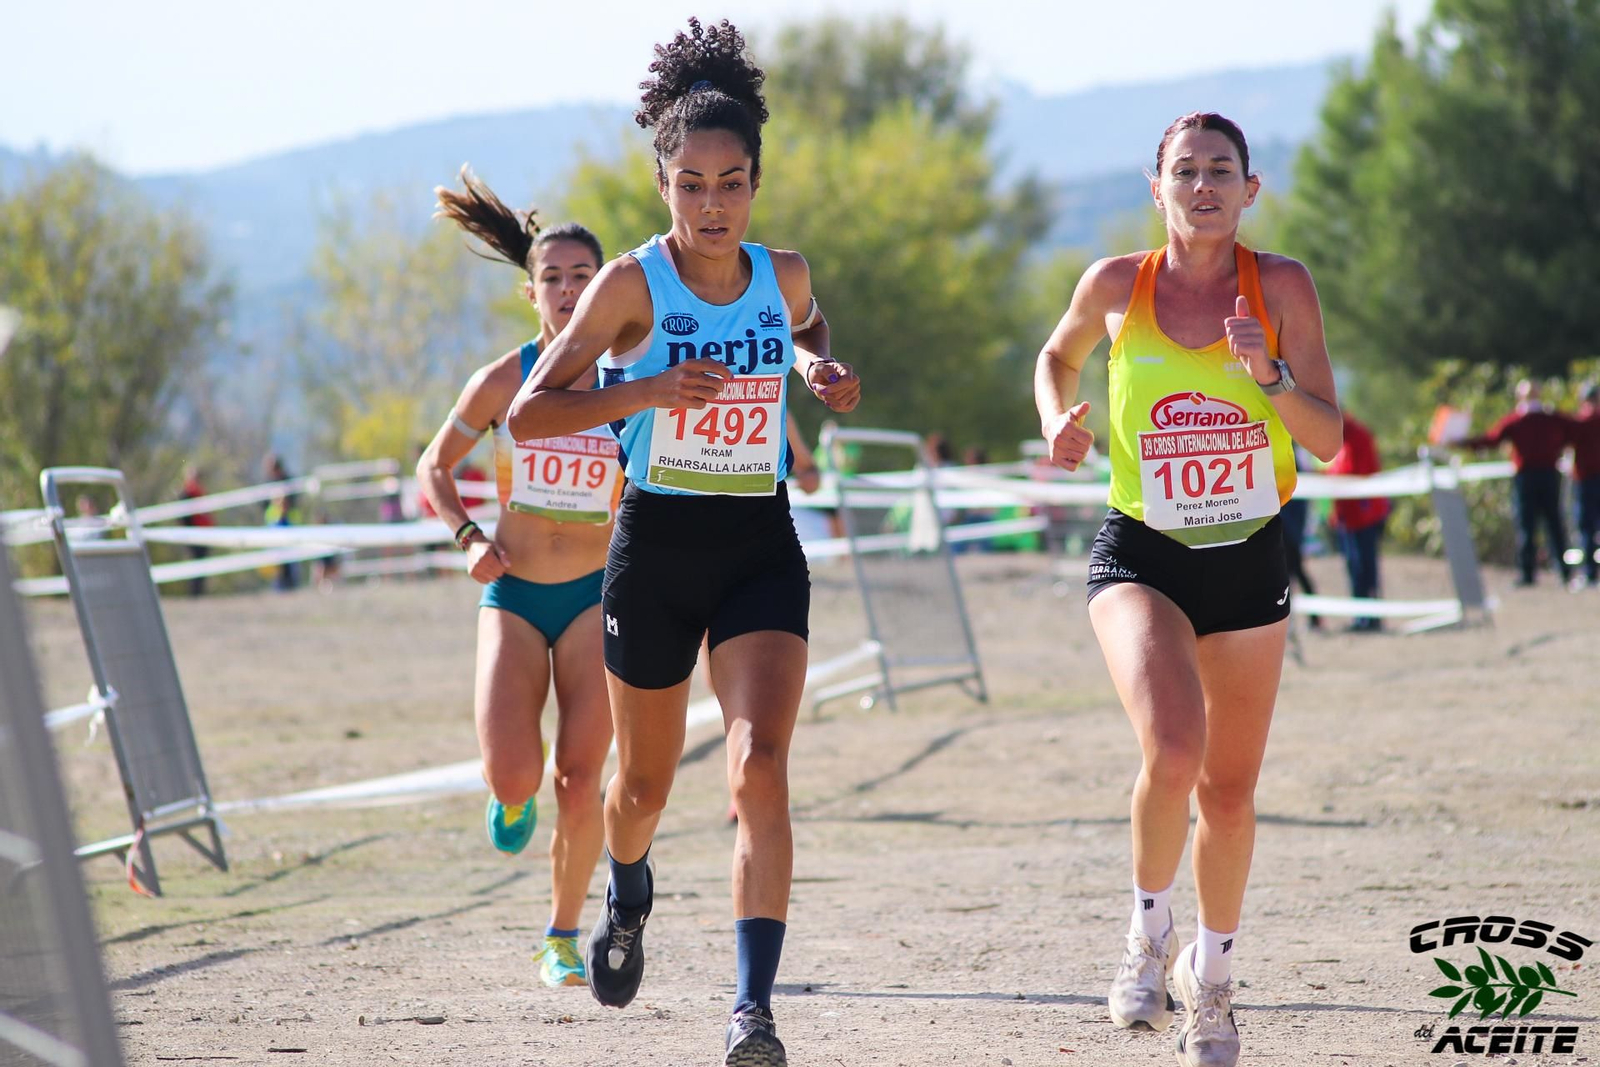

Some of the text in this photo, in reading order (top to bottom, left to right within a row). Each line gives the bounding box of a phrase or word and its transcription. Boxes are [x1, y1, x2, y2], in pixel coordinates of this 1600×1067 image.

[663, 317, 698, 331] TROPS
[666, 328, 784, 375] nerja
[746, 381, 756, 400] DEL
[757, 381, 779, 399] ACEITE
[1160, 404, 1240, 427] Serrano
[669, 407, 768, 446] 1492
[1144, 427, 1267, 456] 39 CROSS INTERNACIONAL DEL ACEITE
[701, 447, 733, 458] IKRAM
[522, 453, 606, 489] 1019
[658, 455, 771, 473] RHARSALLA LAKTAB
[1154, 453, 1254, 500] 1021
[546, 499, 577, 509] Andrea
[1176, 497, 1240, 511] Perez Moreno
[1184, 511, 1242, 526] Maria Jose
